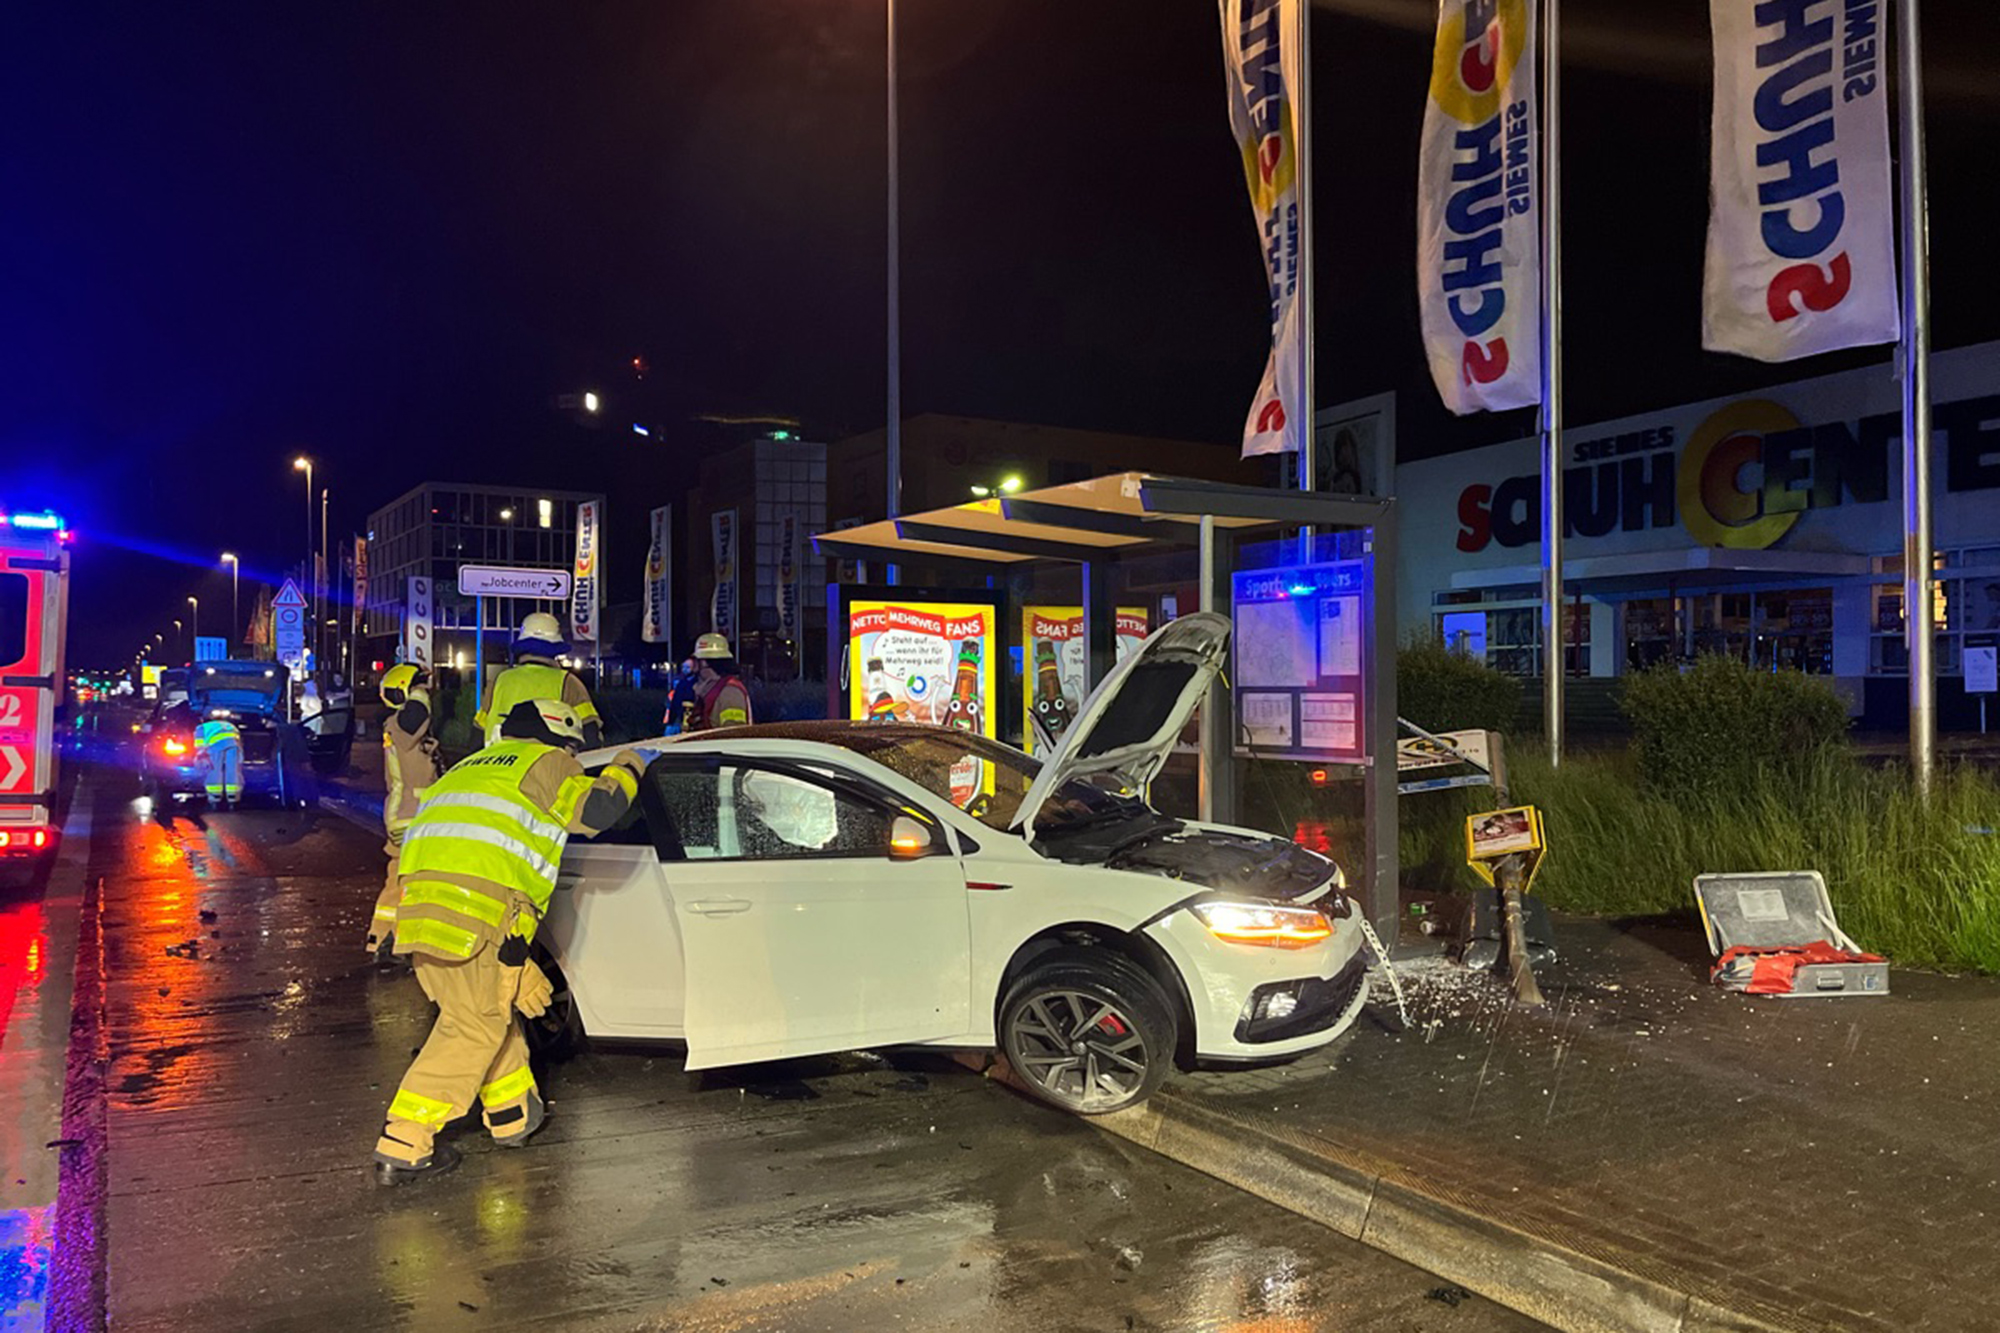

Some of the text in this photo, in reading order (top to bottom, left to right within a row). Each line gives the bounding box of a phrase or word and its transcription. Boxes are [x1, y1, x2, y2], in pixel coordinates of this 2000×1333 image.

[1573, 426, 1674, 461] SIEMES
[490, 576, 542, 588] Jobcenter
[889, 611, 941, 633] MEHRWEG
[945, 619, 981, 637] FANS
[885, 657, 922, 666] Mehrweg
